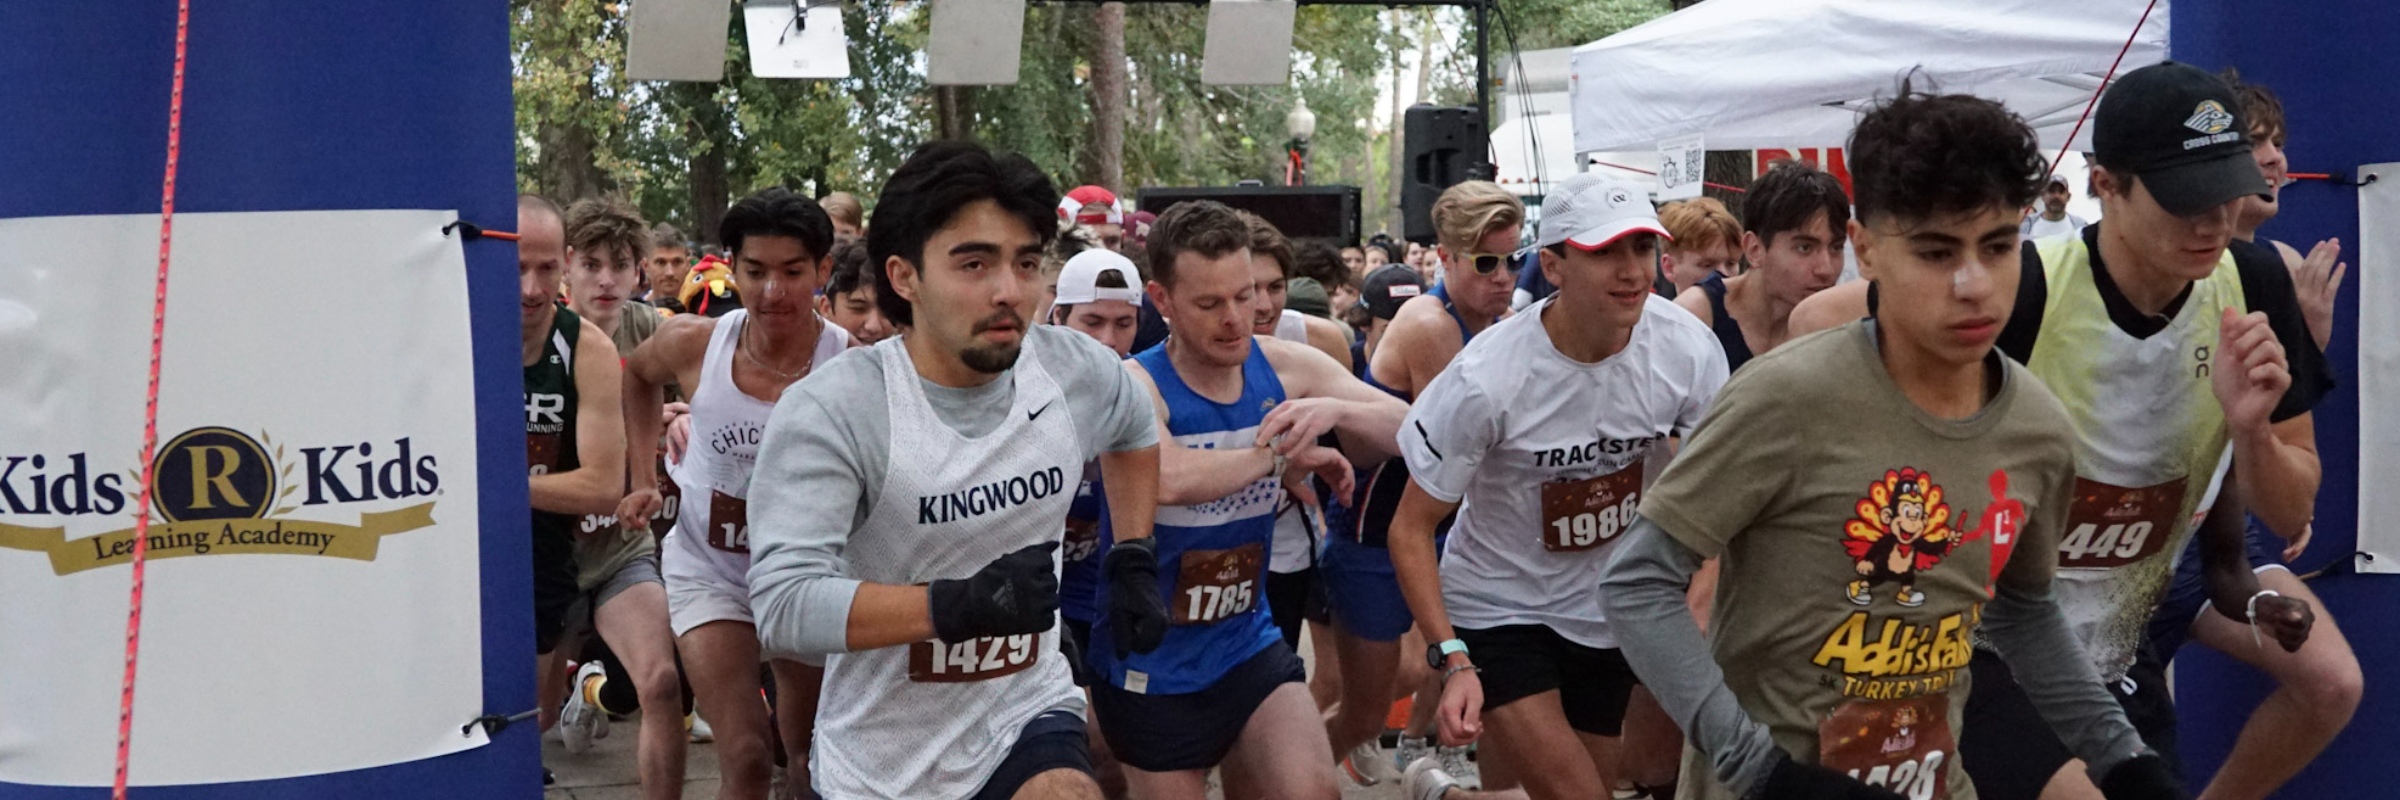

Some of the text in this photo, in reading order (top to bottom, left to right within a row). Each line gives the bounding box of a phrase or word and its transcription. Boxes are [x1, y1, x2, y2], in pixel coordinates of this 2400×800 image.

[0, 437, 439, 515] Kids R Kids
[918, 466, 1063, 524] KINGWOOD
[1552, 492, 1636, 547] 1986
[92, 521, 335, 560] Leaning Academy
[2058, 521, 2153, 559] 449
[1186, 580, 1253, 620] 1785
[926, 633, 1032, 674] 1429
[1844, 676, 1918, 699] TURKEY
